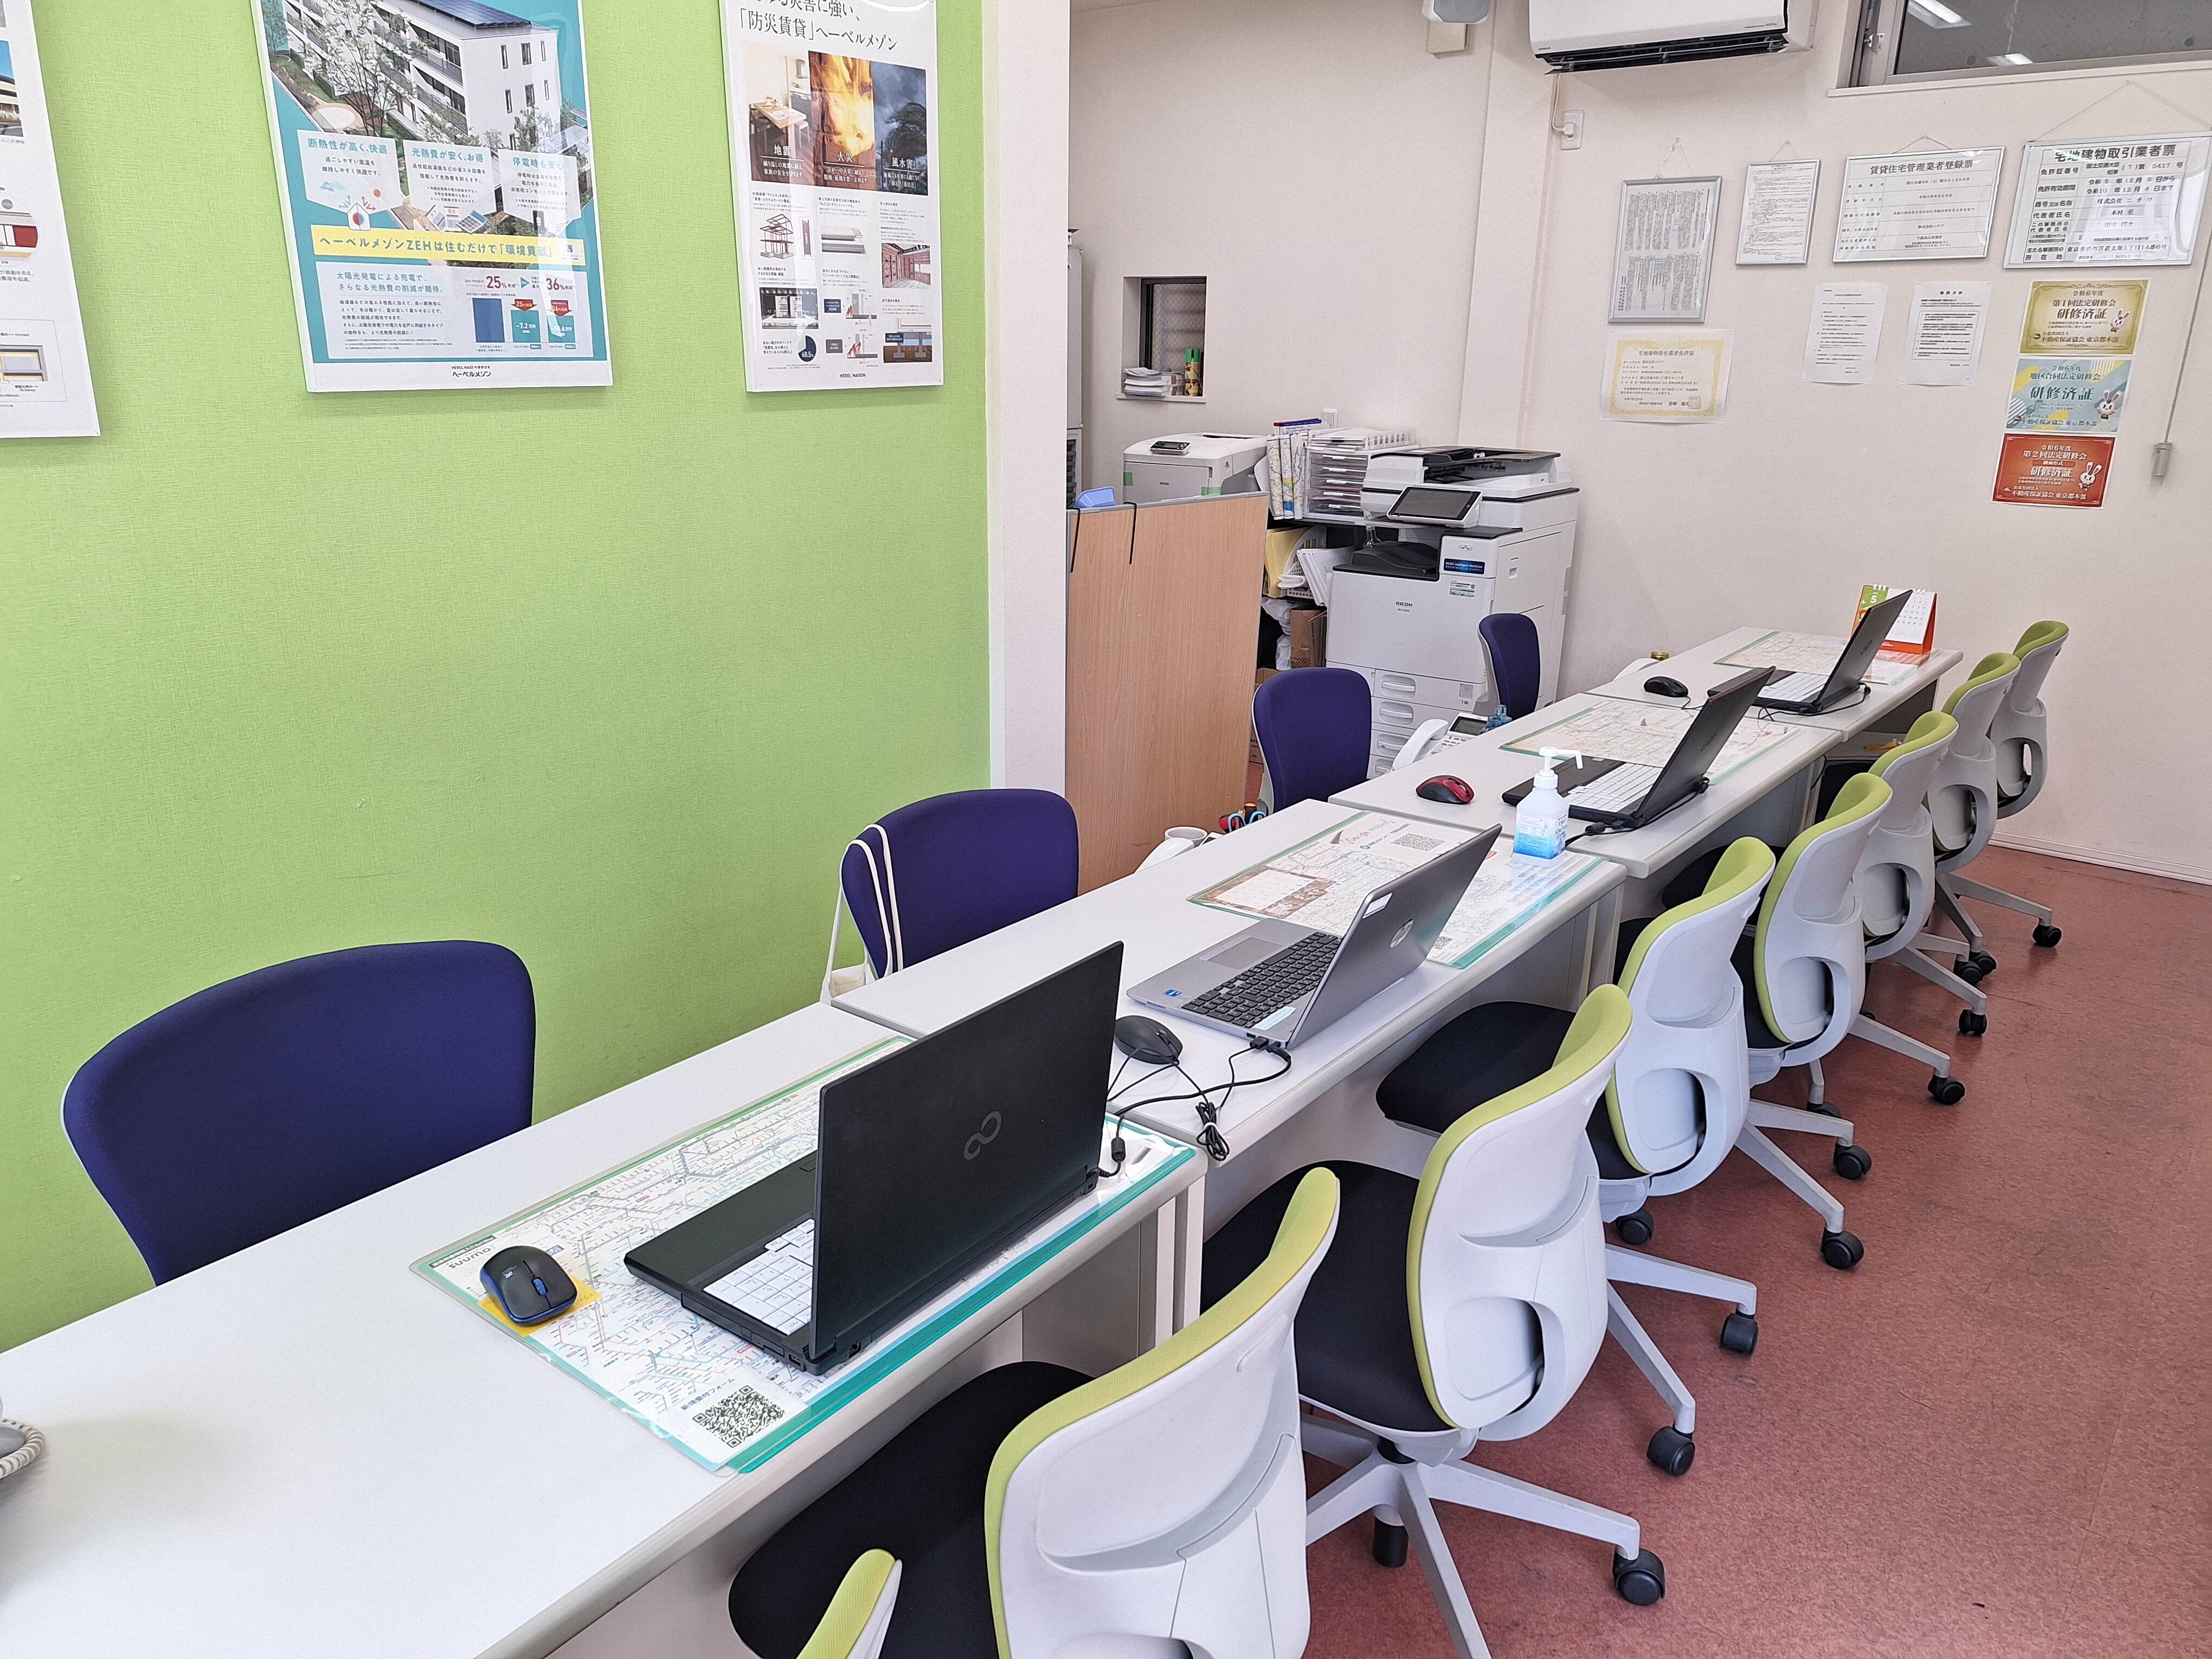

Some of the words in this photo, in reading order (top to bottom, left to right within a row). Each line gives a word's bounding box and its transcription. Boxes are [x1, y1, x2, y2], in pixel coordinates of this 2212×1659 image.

[741, 8, 898, 50] 「防災賃貸」ヘーベルメゾン
[307, 138, 387, 155] 断熱性が高く、快適
[774, 144, 790, 156] 地震
[412, 147, 484, 163] 光熱費が安く、お得
[837, 151, 853, 163] 火災
[2054, 144, 2176, 162] 宅地建物取引業者票
[892, 157, 913, 169] 風水害
[1870, 159, 1973, 175] 賃貸住宅管理業者登録票
[2041, 167, 2079, 175] 免許証番号
[337, 272, 427, 282] 太陽光発電による売電で、
[339, 283, 443, 293] さらなる光熱費の削減が期待。
[2053, 299, 2117, 307] 第1回法定研修会
[2057, 308, 2108, 319] 研修済証
[2030, 372, 2101, 381] 地区合同法定研修会
[2030, 386, 2094, 400] 研修済証
[2023, 450, 2087, 460] 第2回法定研修会
[2030, 467, 2073, 478] 研修済証
[1870, 595, 1877, 603] 5
[448, 1247, 491, 1269] suumo
